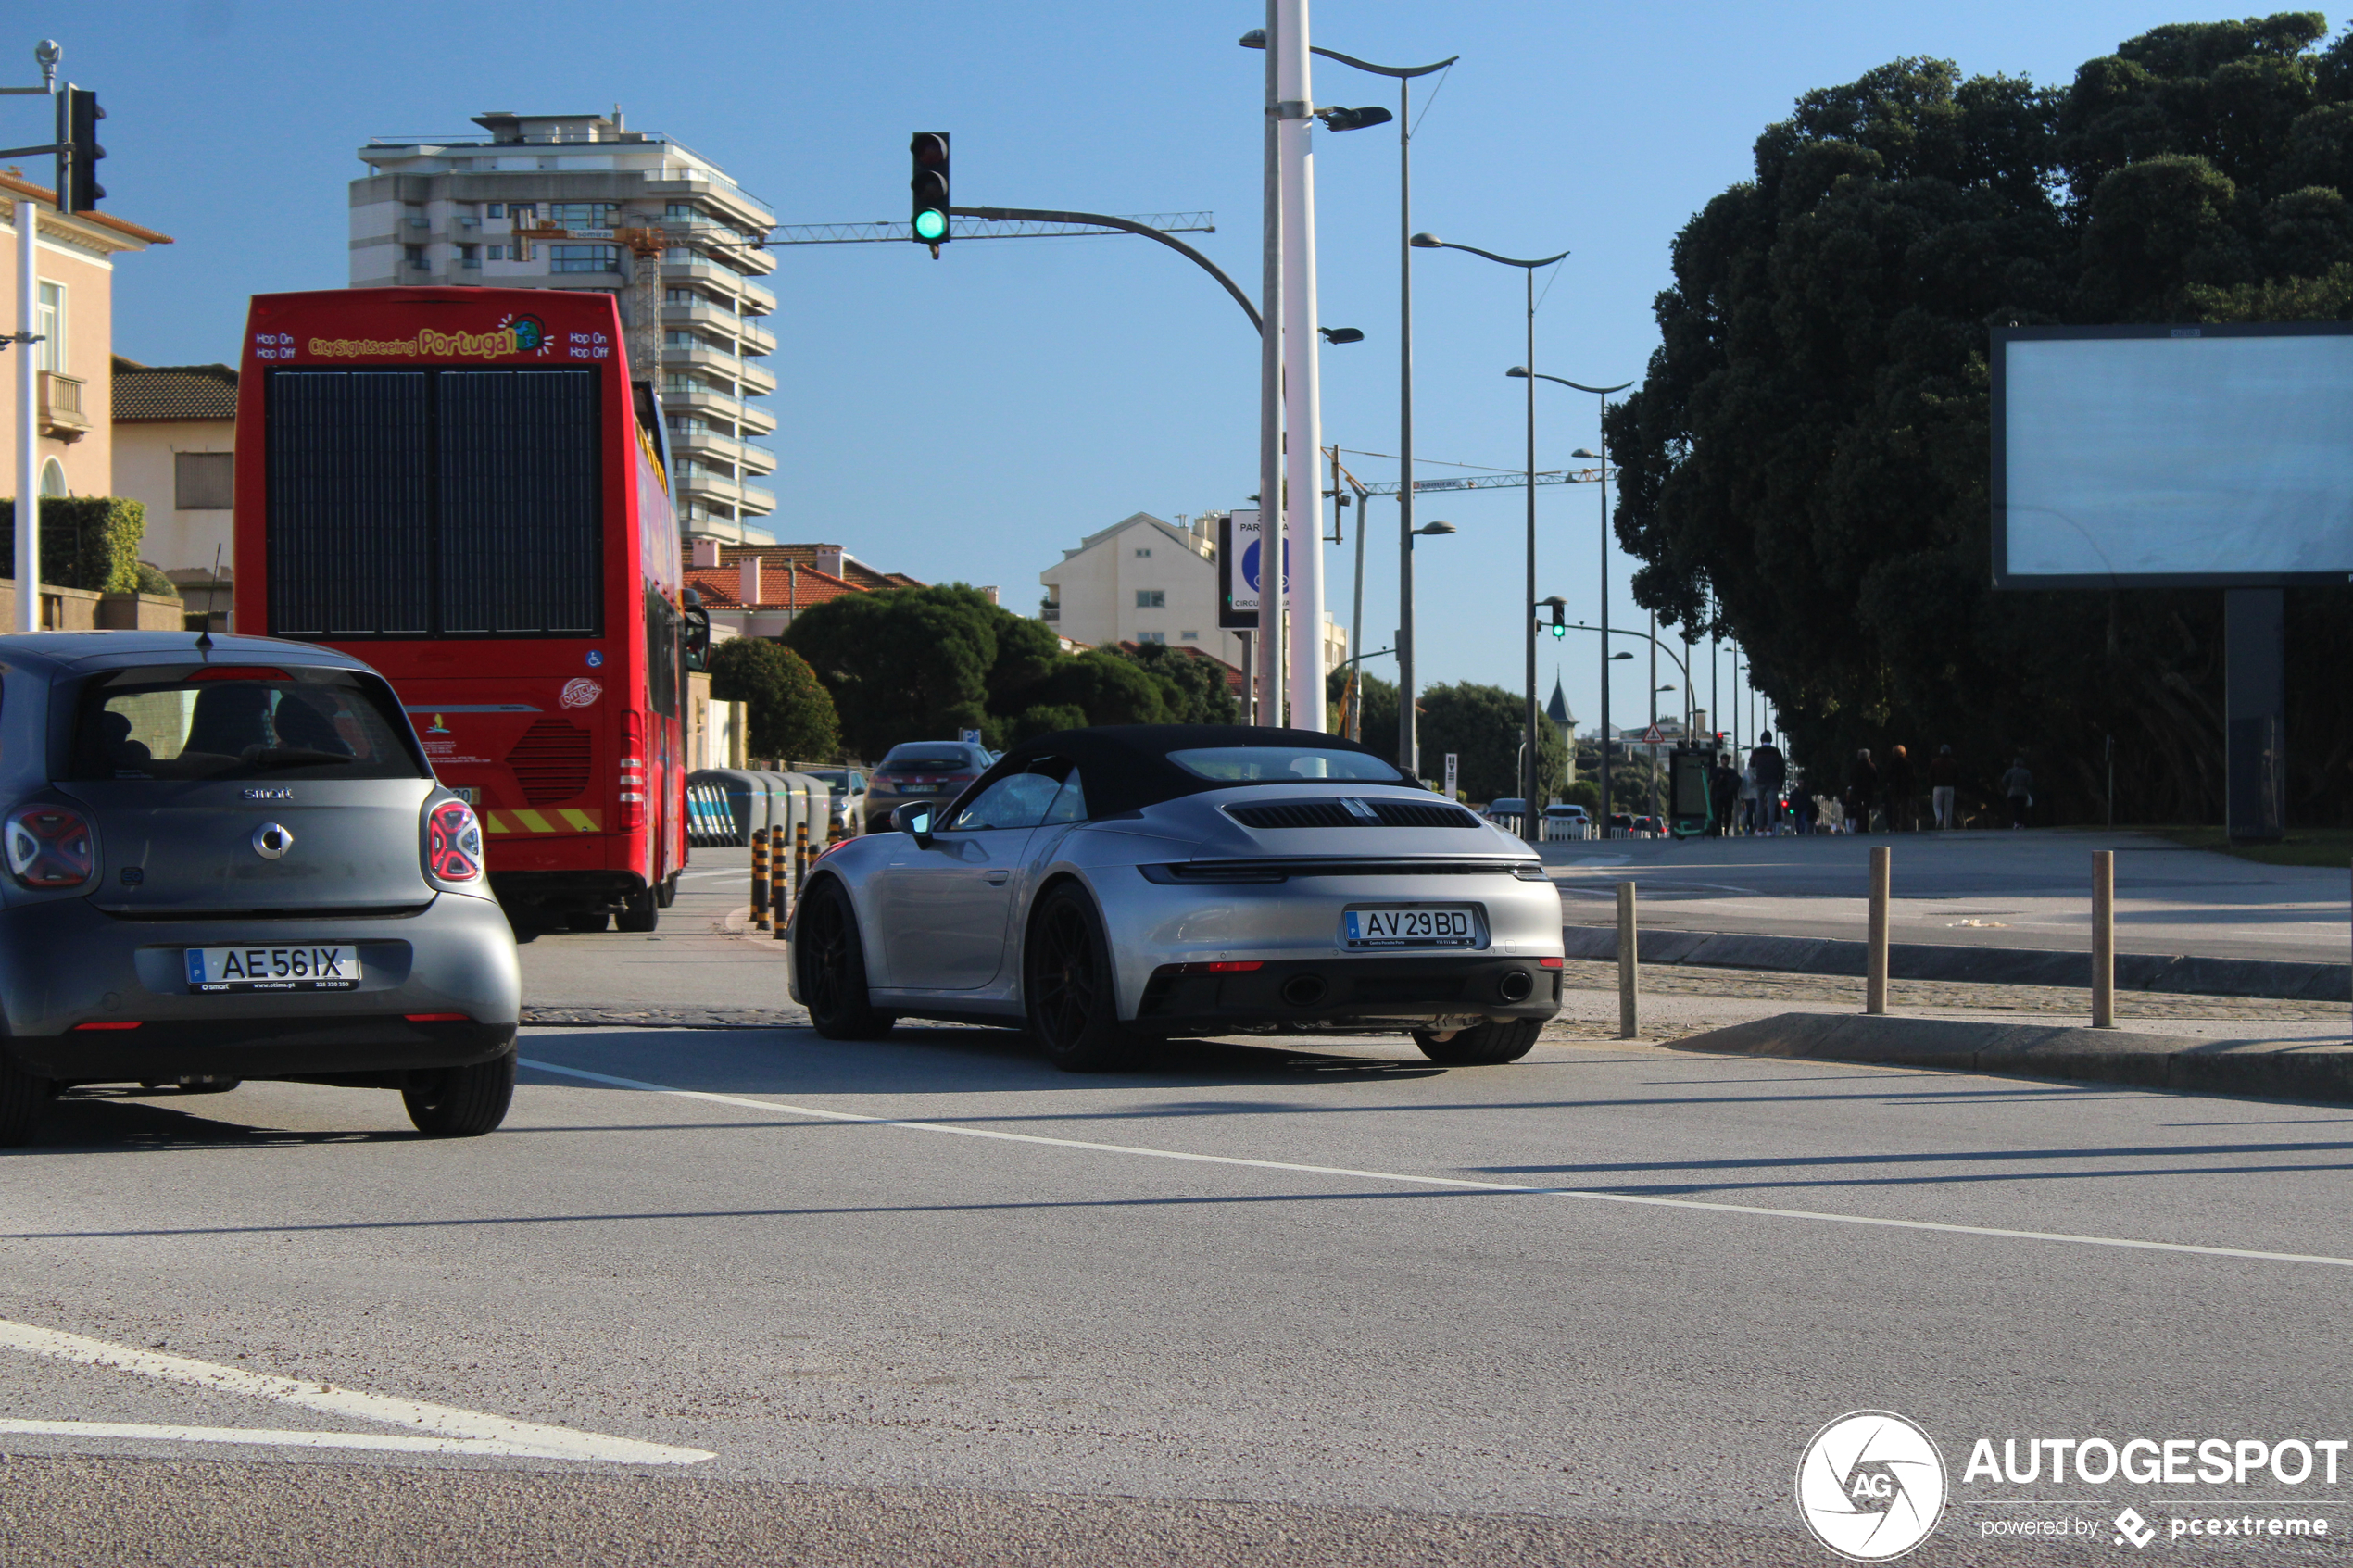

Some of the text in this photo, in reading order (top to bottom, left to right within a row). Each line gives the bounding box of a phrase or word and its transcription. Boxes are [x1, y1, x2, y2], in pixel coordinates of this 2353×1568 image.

[256, 332, 295, 345] Hop On
[419, 328, 517, 359] Portugal
[570, 332, 607, 345] Hop On
[256, 346, 296, 359] Hop Off
[570, 346, 610, 358] Hop Off
[563, 684, 599, 704] OFFICIAL
[244, 786, 294, 799] smart
[122, 872, 142, 881] EQ
[194, 969, 201, 977] P
